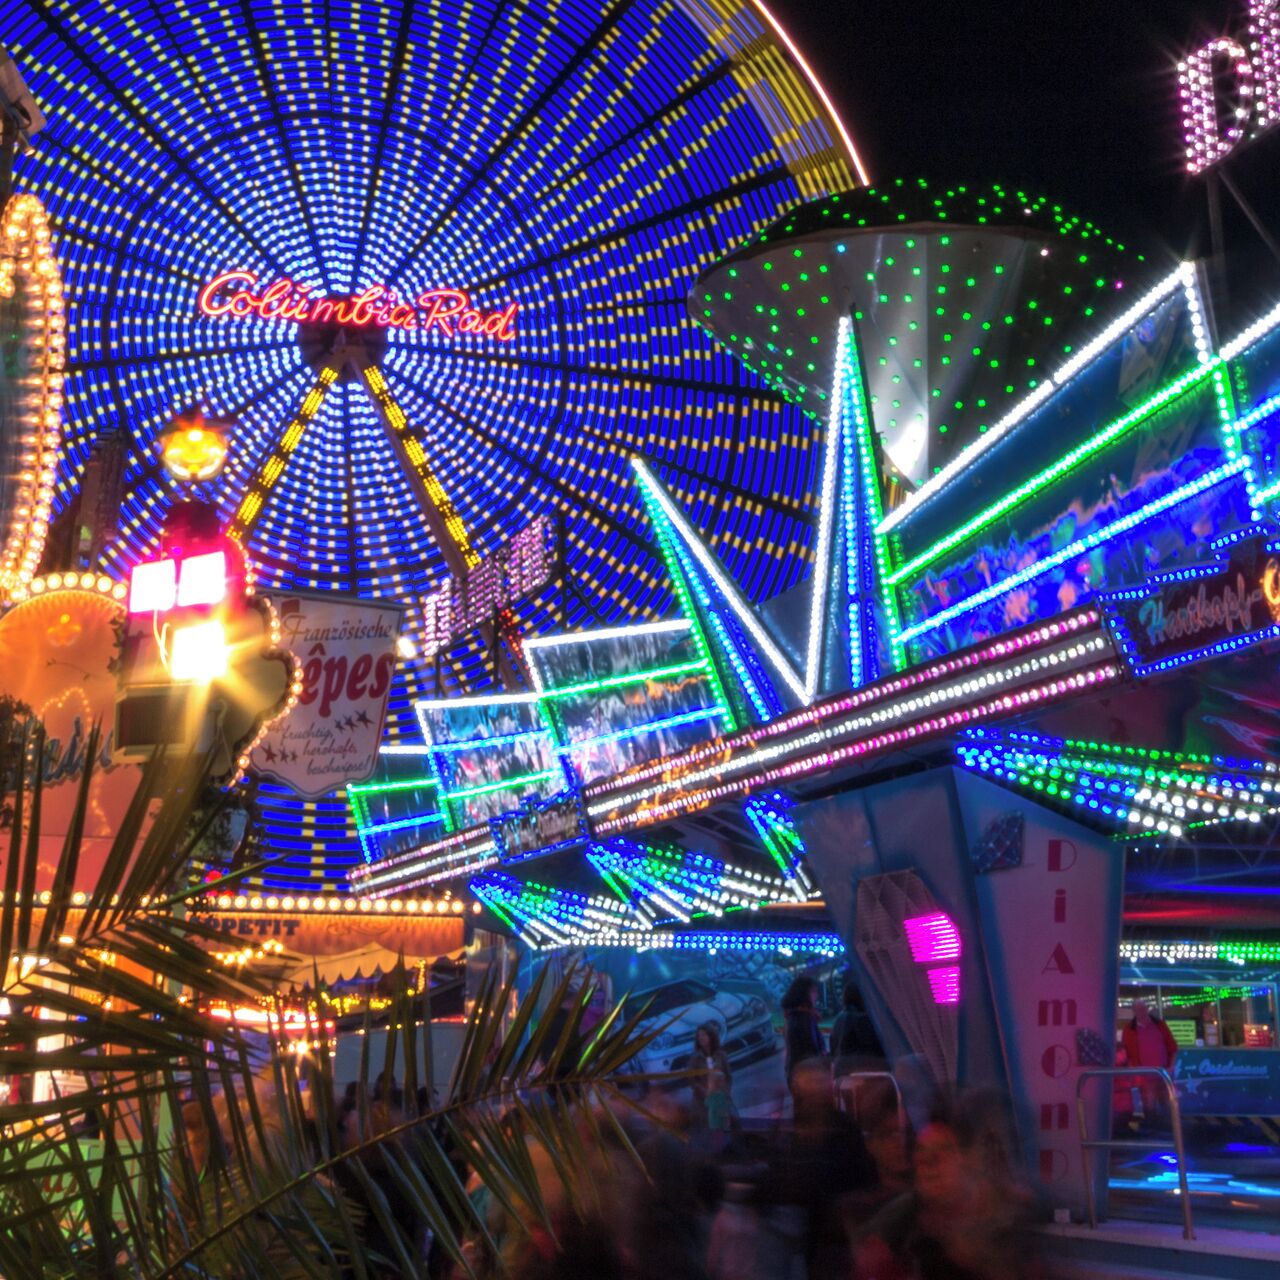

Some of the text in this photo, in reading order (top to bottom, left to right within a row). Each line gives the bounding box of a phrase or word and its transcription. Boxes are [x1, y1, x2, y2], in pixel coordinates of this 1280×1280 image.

[199, 269, 522, 342] Columbia Rad
[283, 613, 393, 646] Französische
[299, 642, 395, 718] êpes
